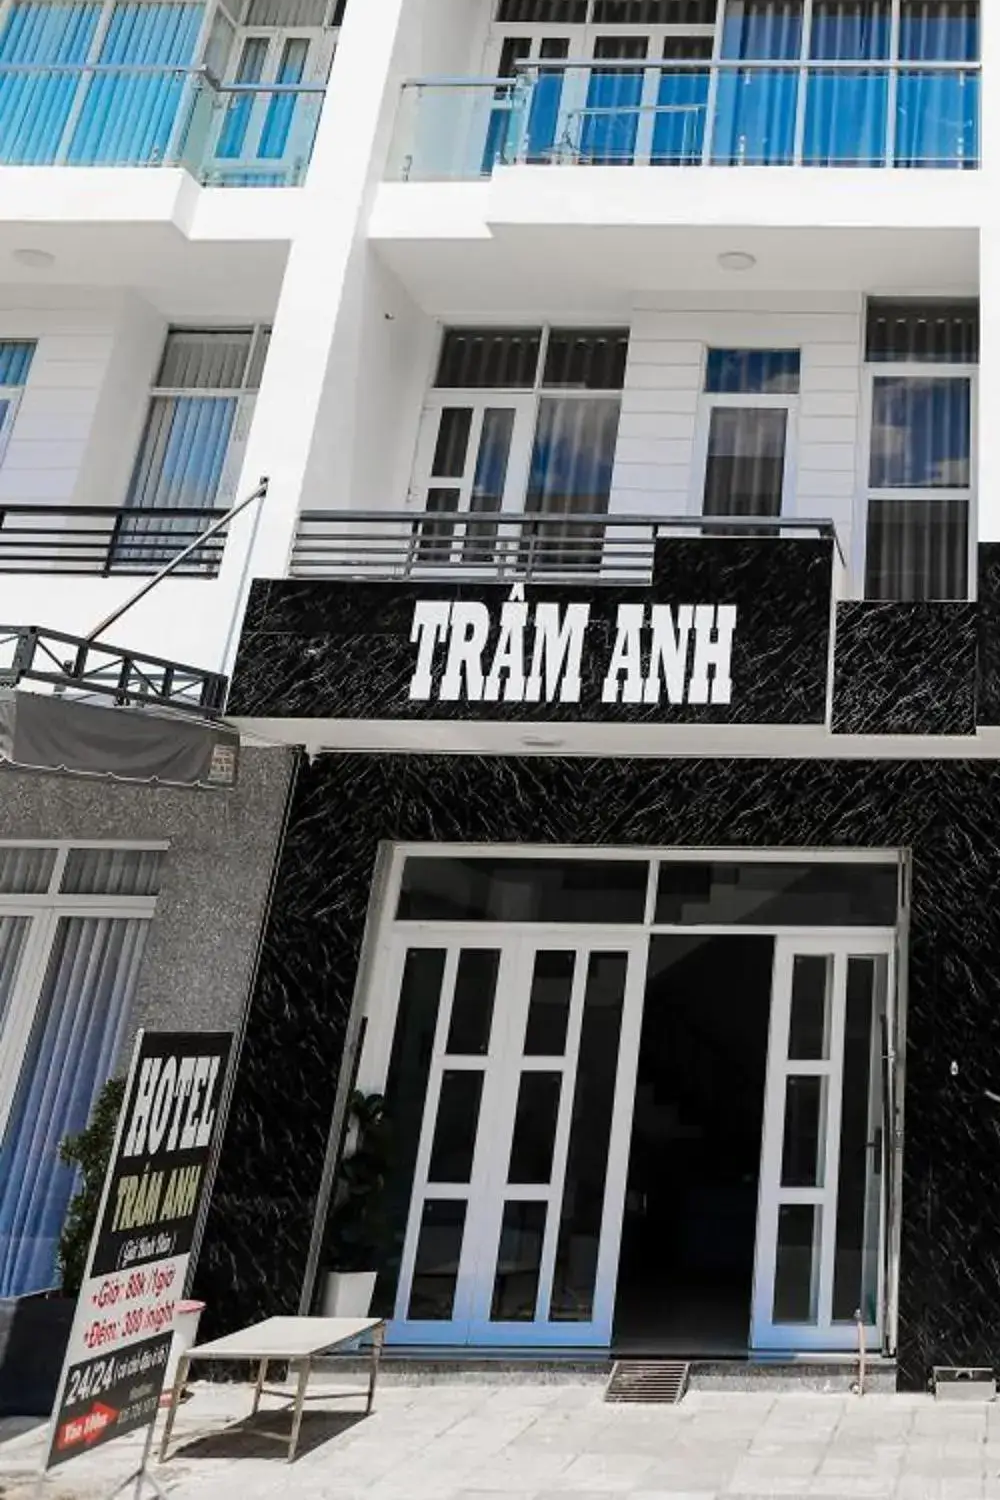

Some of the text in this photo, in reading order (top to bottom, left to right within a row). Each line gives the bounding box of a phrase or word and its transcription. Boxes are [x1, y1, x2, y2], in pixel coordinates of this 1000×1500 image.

[408, 582, 738, 704] TRÂM ANH
[123, 1055, 221, 1157] HOTEL
[159, 1165, 201, 1222] ANH
[65, 1356, 115, 1407] 24/24
